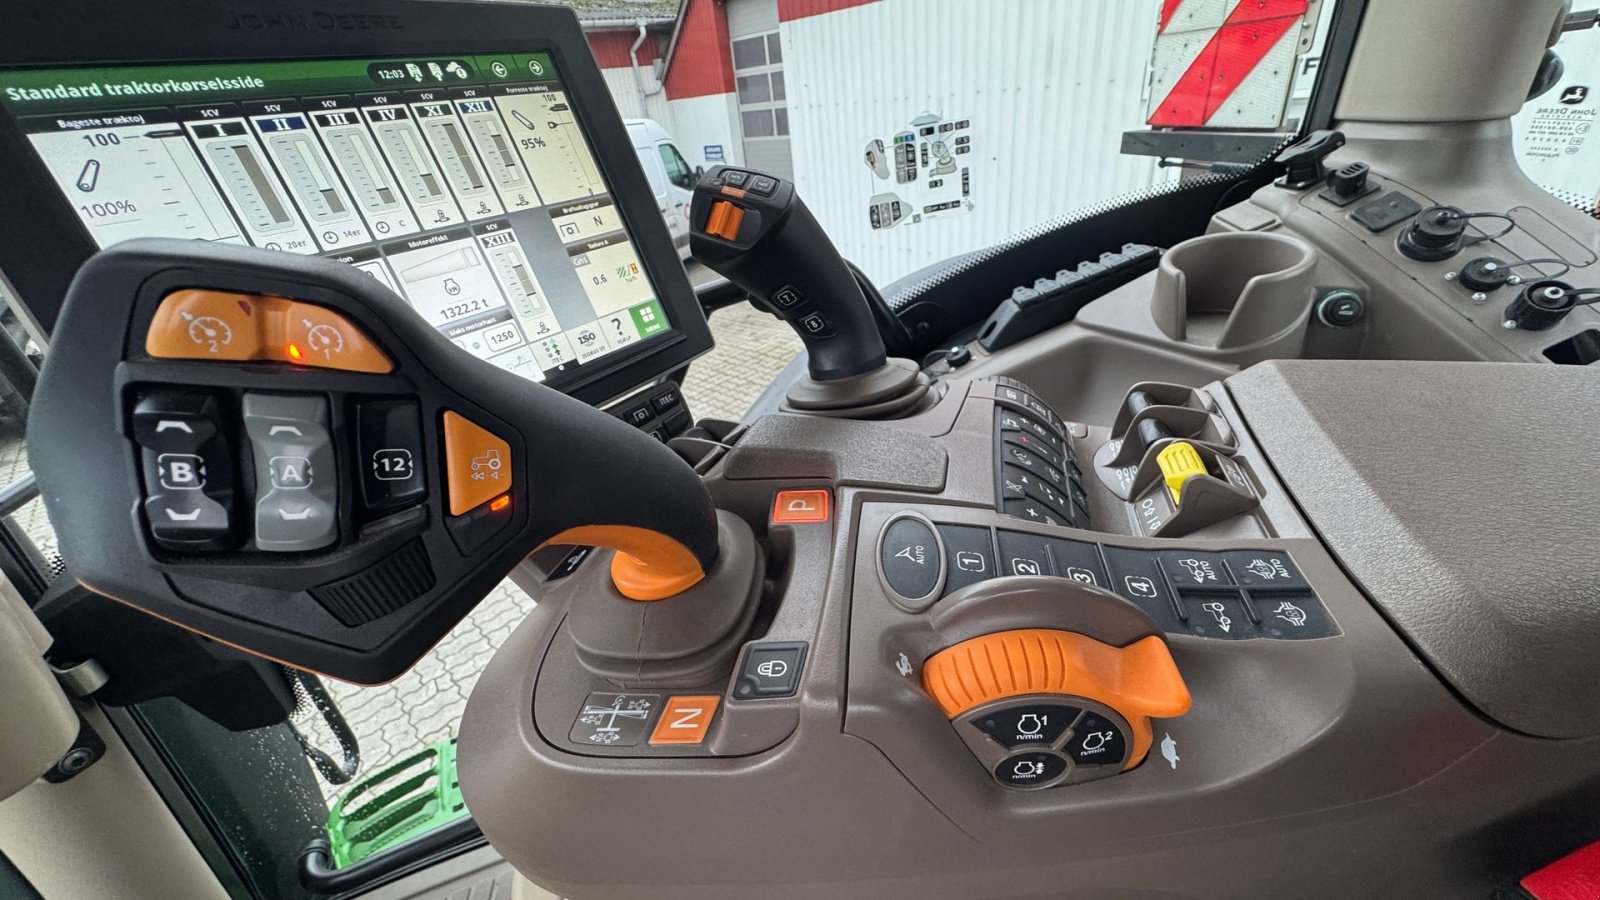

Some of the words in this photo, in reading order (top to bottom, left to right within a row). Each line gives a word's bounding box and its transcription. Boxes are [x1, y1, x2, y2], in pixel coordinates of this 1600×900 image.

[227, 14, 311, 31] JOHN
[312, 12, 403, 30] DEERE
[378, 69, 405, 80] 12:03
[5, 83, 102, 101] Standard
[105, 76, 264, 97] traktorkørselsside
[321, 100, 337, 108] SCV
[373, 96, 387, 104] SCV
[542, 94, 556, 102] 100
[201, 108, 219, 117] SCV
[264, 104, 281, 113] SCV
[426, 105, 444, 116] XI
[467, 101, 486, 113] XII
[325, 114, 347, 126] III
[377, 109, 396, 121] IV
[57, 118, 100, 129] Bageste
[272, 118, 291, 131] II
[212, 124, 227, 137] I
[83, 132, 120, 147] 100
[521, 137, 546, 150] 95%
[81, 200, 136, 219] 100%
[593, 216, 603, 227] N
[407, 235, 449, 249] Motoreffekt
[485, 233, 512, 248] XIII
[593, 274, 607, 285] 0.6
[441, 300, 481, 320] 1322.2
[482, 298, 489, 308] t
[491, 330, 514, 344] 1250
[578, 332, 596, 345] ISO
[208, 340, 218, 352] 2
[324, 348, 330, 361] 1
[380, 457, 405, 472] 12
[170, 461, 193, 482] B
[281, 463, 302, 482] A
[788, 499, 815, 511] P
[915, 545, 925, 565] AUTO
[964, 558, 980, 566] 1
[1270, 558, 1291, 578] AUTO
[1020, 564, 1036, 575] 2
[1200, 560, 1218, 581] AUTO
[1131, 581, 1150, 592] 4
[670, 708, 703, 729] N
[1041, 715, 1048, 726] 1
[1105, 731, 1113, 741] 2
[1080, 747, 1106, 756] n/min
